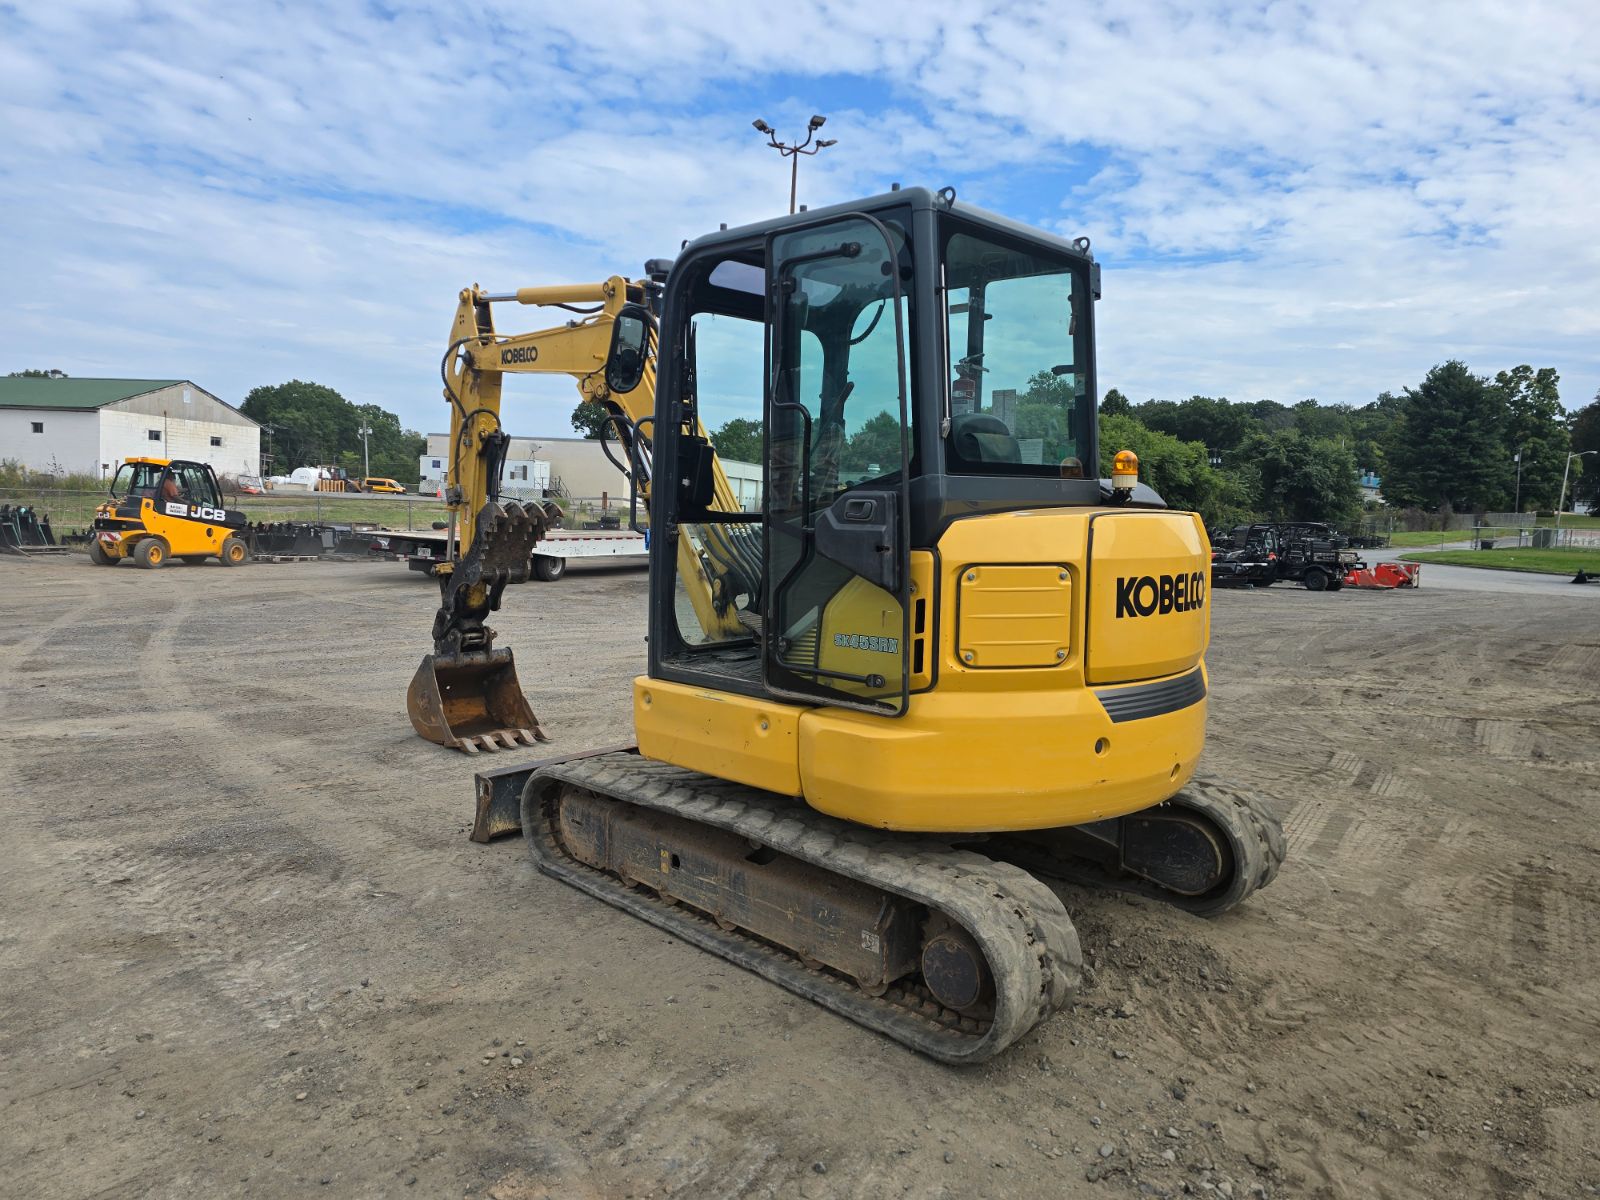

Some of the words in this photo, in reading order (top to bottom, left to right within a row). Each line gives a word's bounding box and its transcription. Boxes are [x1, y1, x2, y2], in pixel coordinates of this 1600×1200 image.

[501, 346, 538, 365] KOBELCO
[190, 506, 226, 521] JCB
[1116, 571, 1204, 618] KOBELCO
[834, 633, 899, 654] SK45SRX
